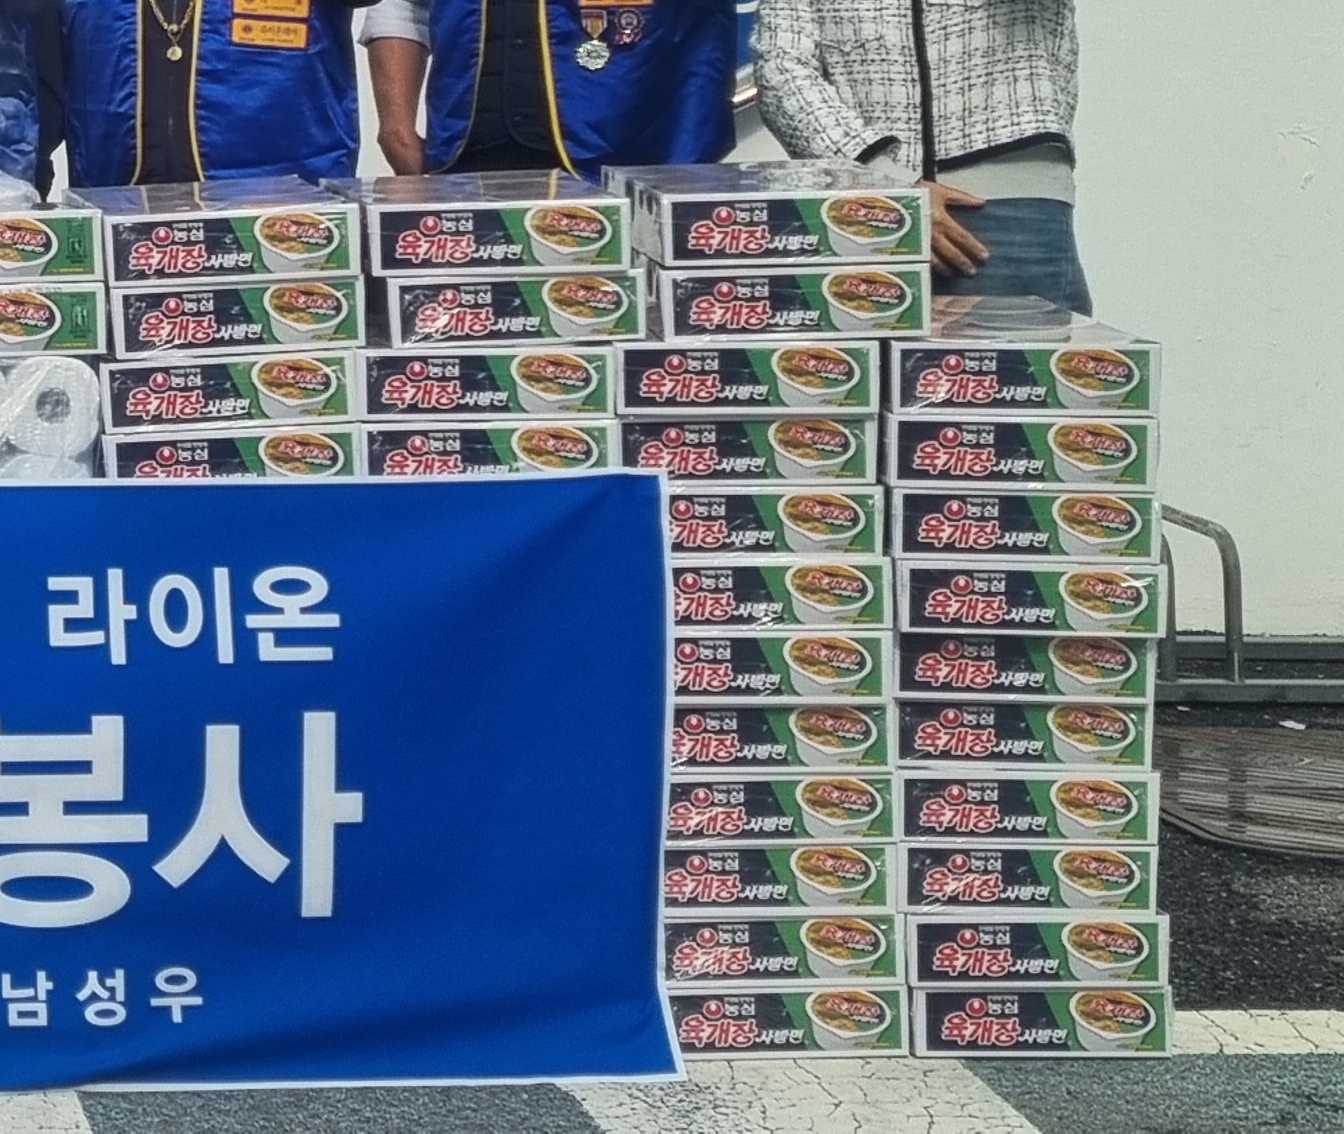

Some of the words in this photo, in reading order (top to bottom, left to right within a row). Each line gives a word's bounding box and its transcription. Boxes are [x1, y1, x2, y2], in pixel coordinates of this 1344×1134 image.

[736, 206, 768, 221] 농심
[689, 222, 769, 254] 육개장
[47, 562, 342, 665] 라이온
[987, 1001, 1019, 1016] 농심
[941, 1016, 1020, 1047] 육개장
